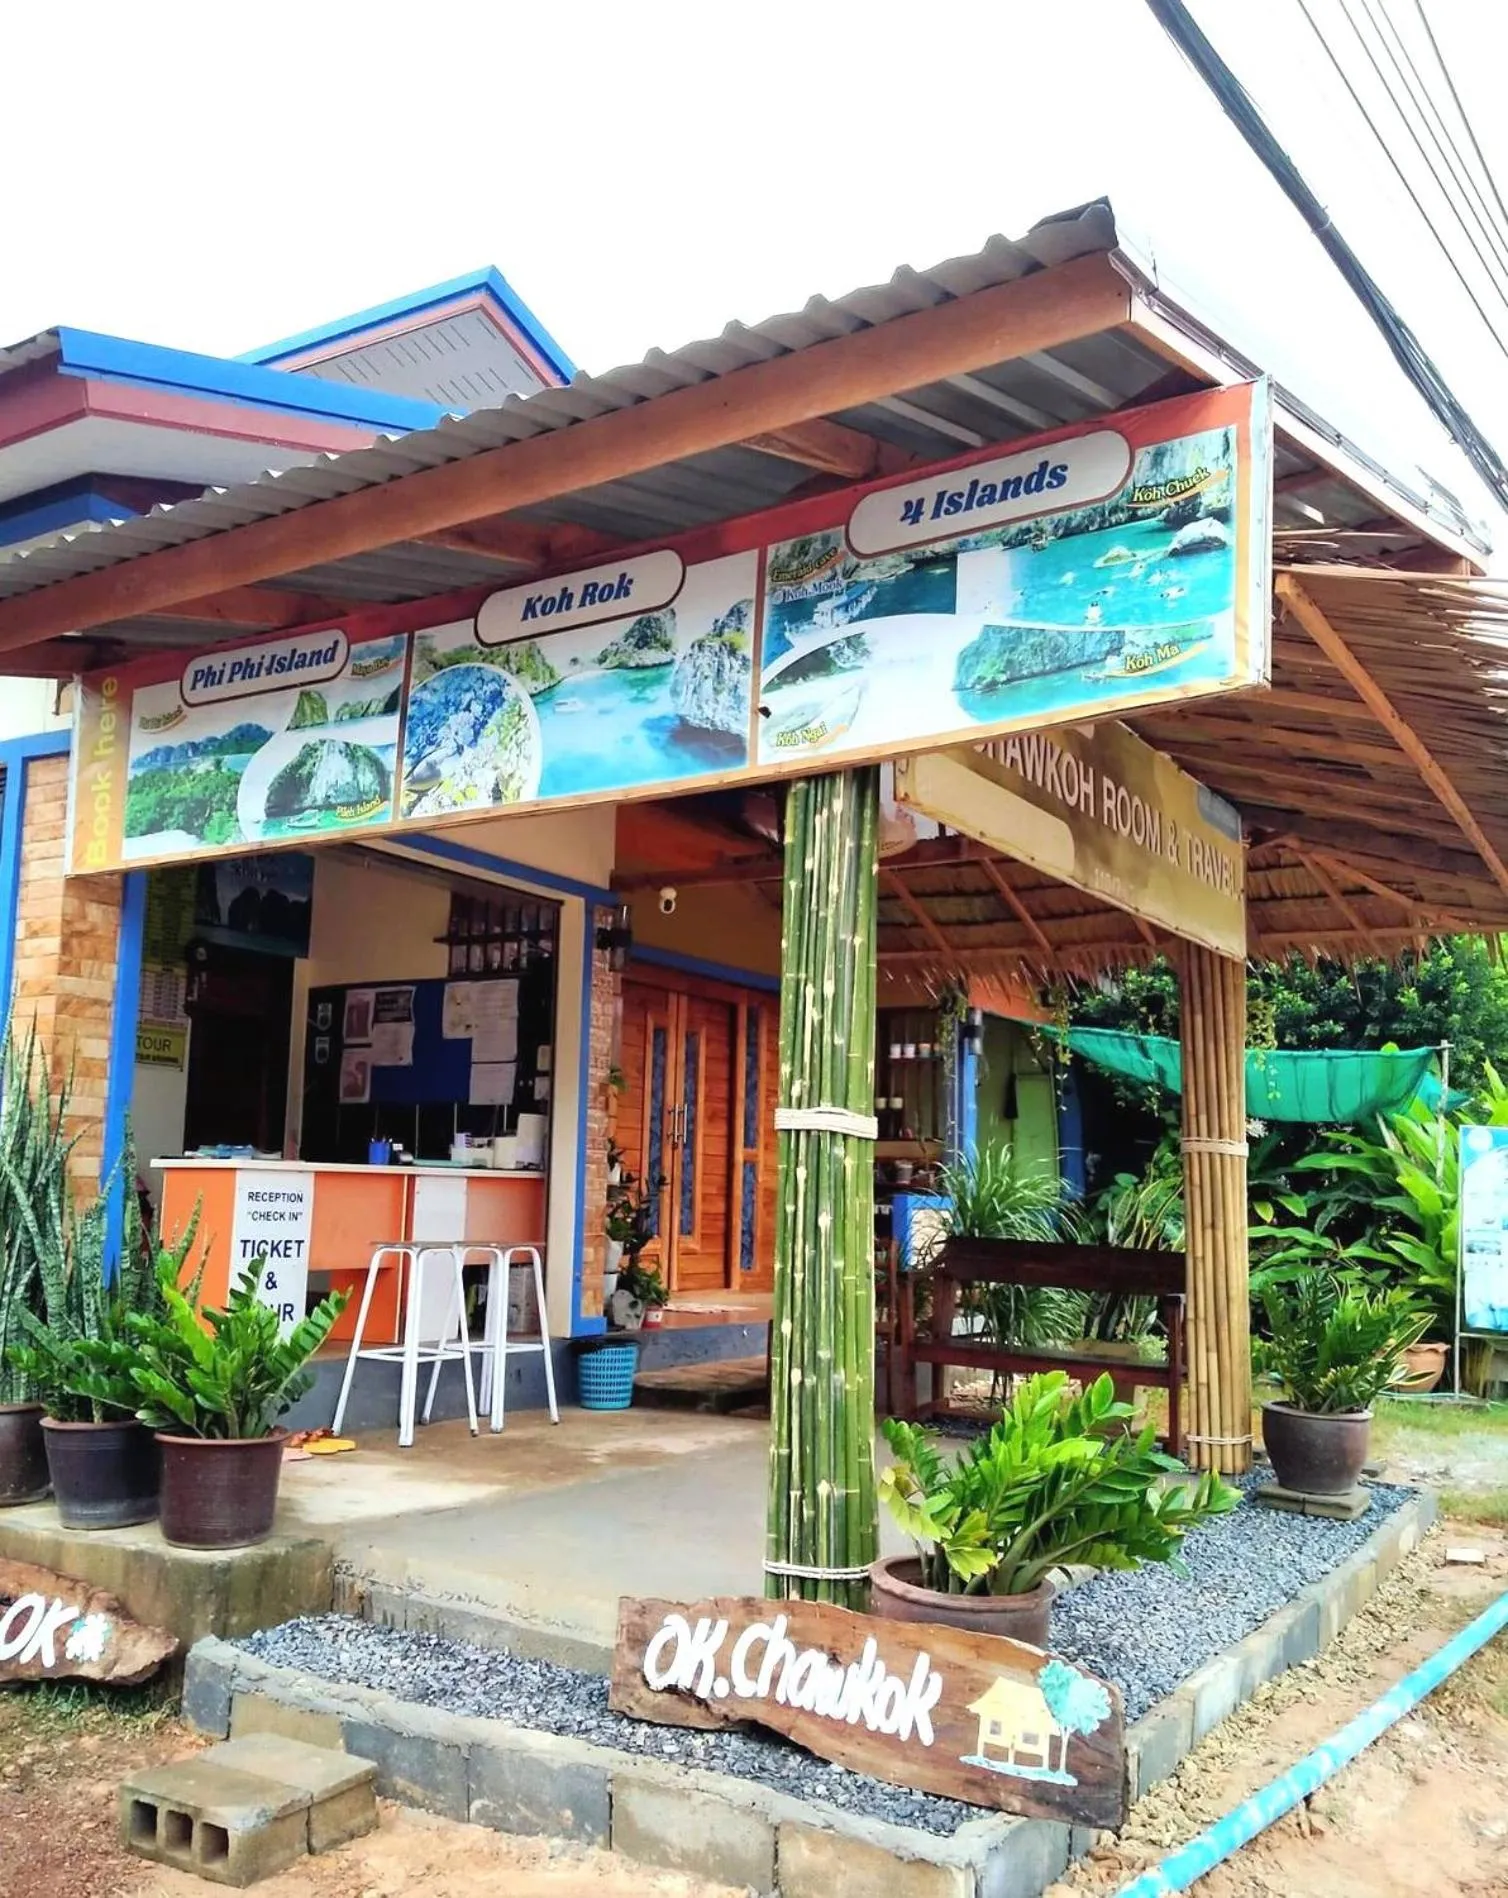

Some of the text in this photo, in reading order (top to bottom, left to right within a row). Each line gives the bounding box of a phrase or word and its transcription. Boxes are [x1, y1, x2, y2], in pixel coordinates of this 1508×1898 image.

[899, 460, 1069, 526] 4 Islands
[1132, 485, 1160, 502] Koh
[520, 572, 634, 621] Koh Rok
[189, 640, 340, 692] Phi Phi Island
[1125, 643, 1180, 672] Koh Ma
[84, 676, 119, 867] Book here
[1102, 775, 1162, 857] ROOM
[1167, 819, 1181, 867] &
[1183, 829, 1241, 901] TRAVEL
[247, 1191, 304, 1204] RECEPTION
[239, 1239, 305, 1259] TICKET
[264, 1271, 278, 1291] &
[0, 1592, 80, 1668] OK
